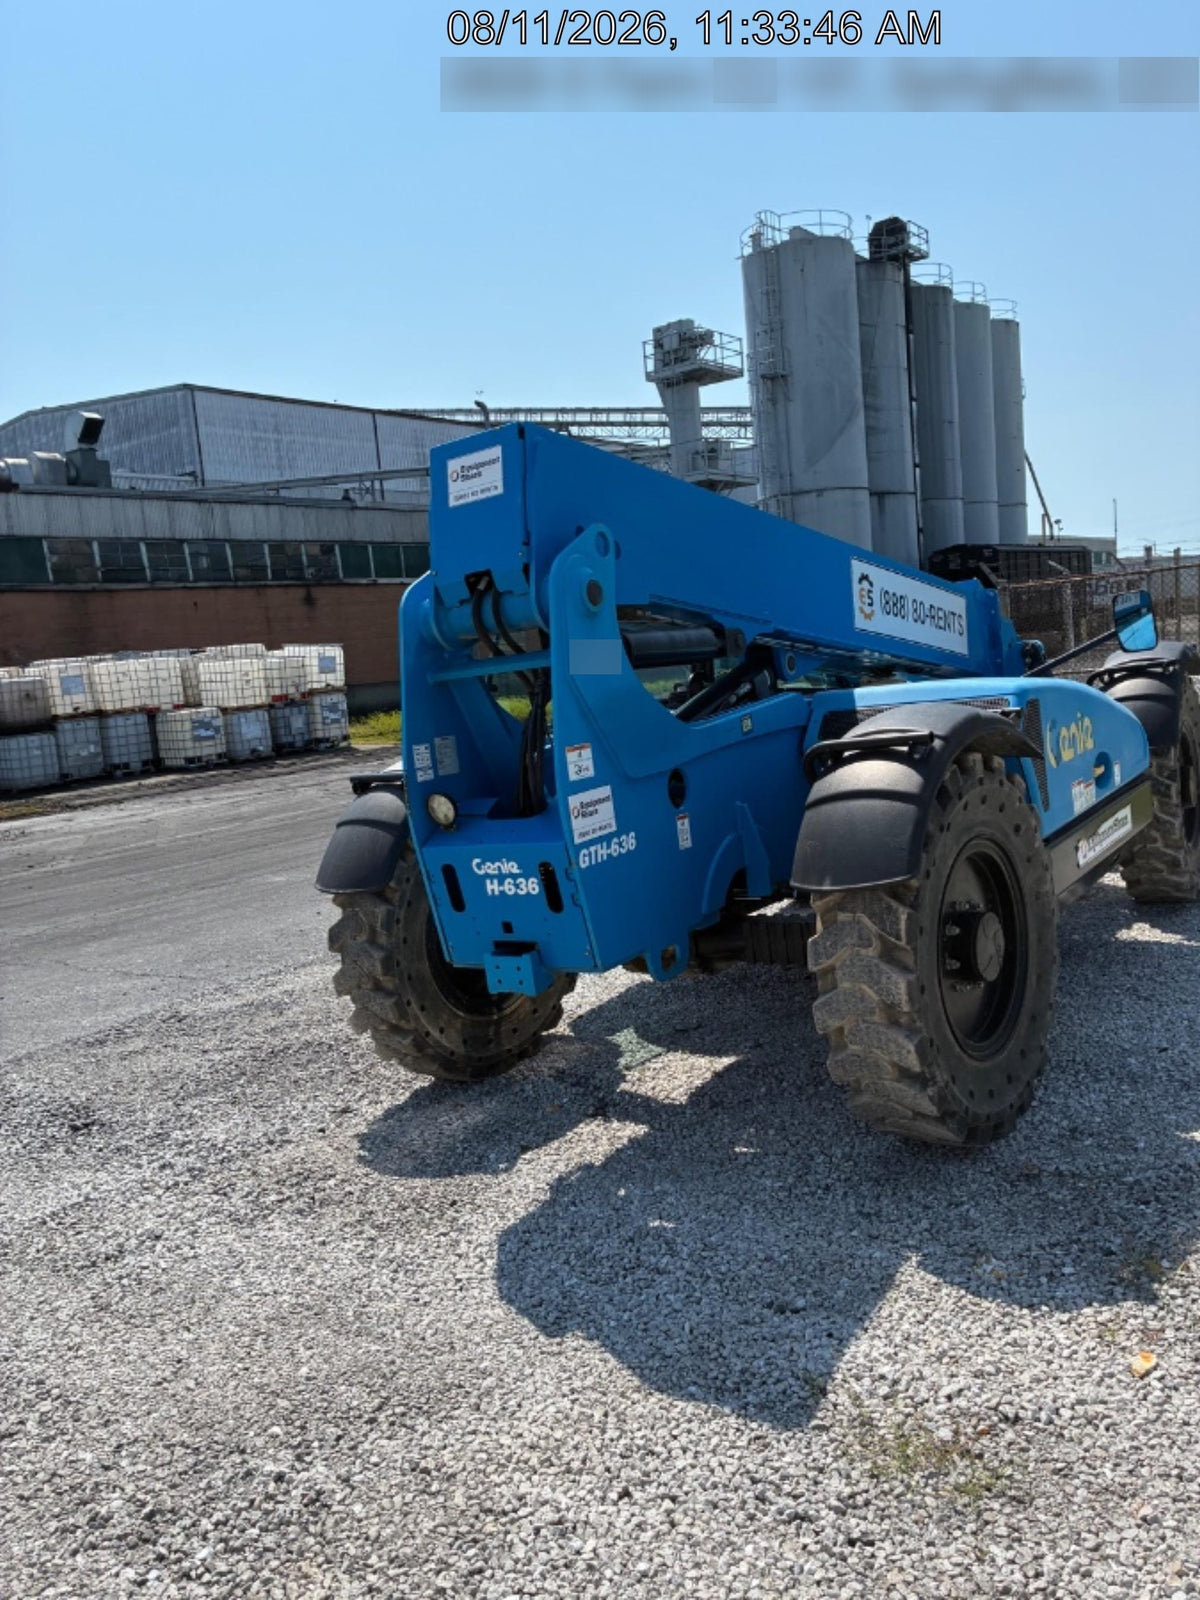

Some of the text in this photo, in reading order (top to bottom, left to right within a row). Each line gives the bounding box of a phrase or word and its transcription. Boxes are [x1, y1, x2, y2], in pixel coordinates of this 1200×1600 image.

[880, 587, 965, 637] (888) 80-RENTS
[579, 831, 637, 869] GTH-636
[472, 858, 523, 875] Genie
[485, 877, 540, 896] H-636
